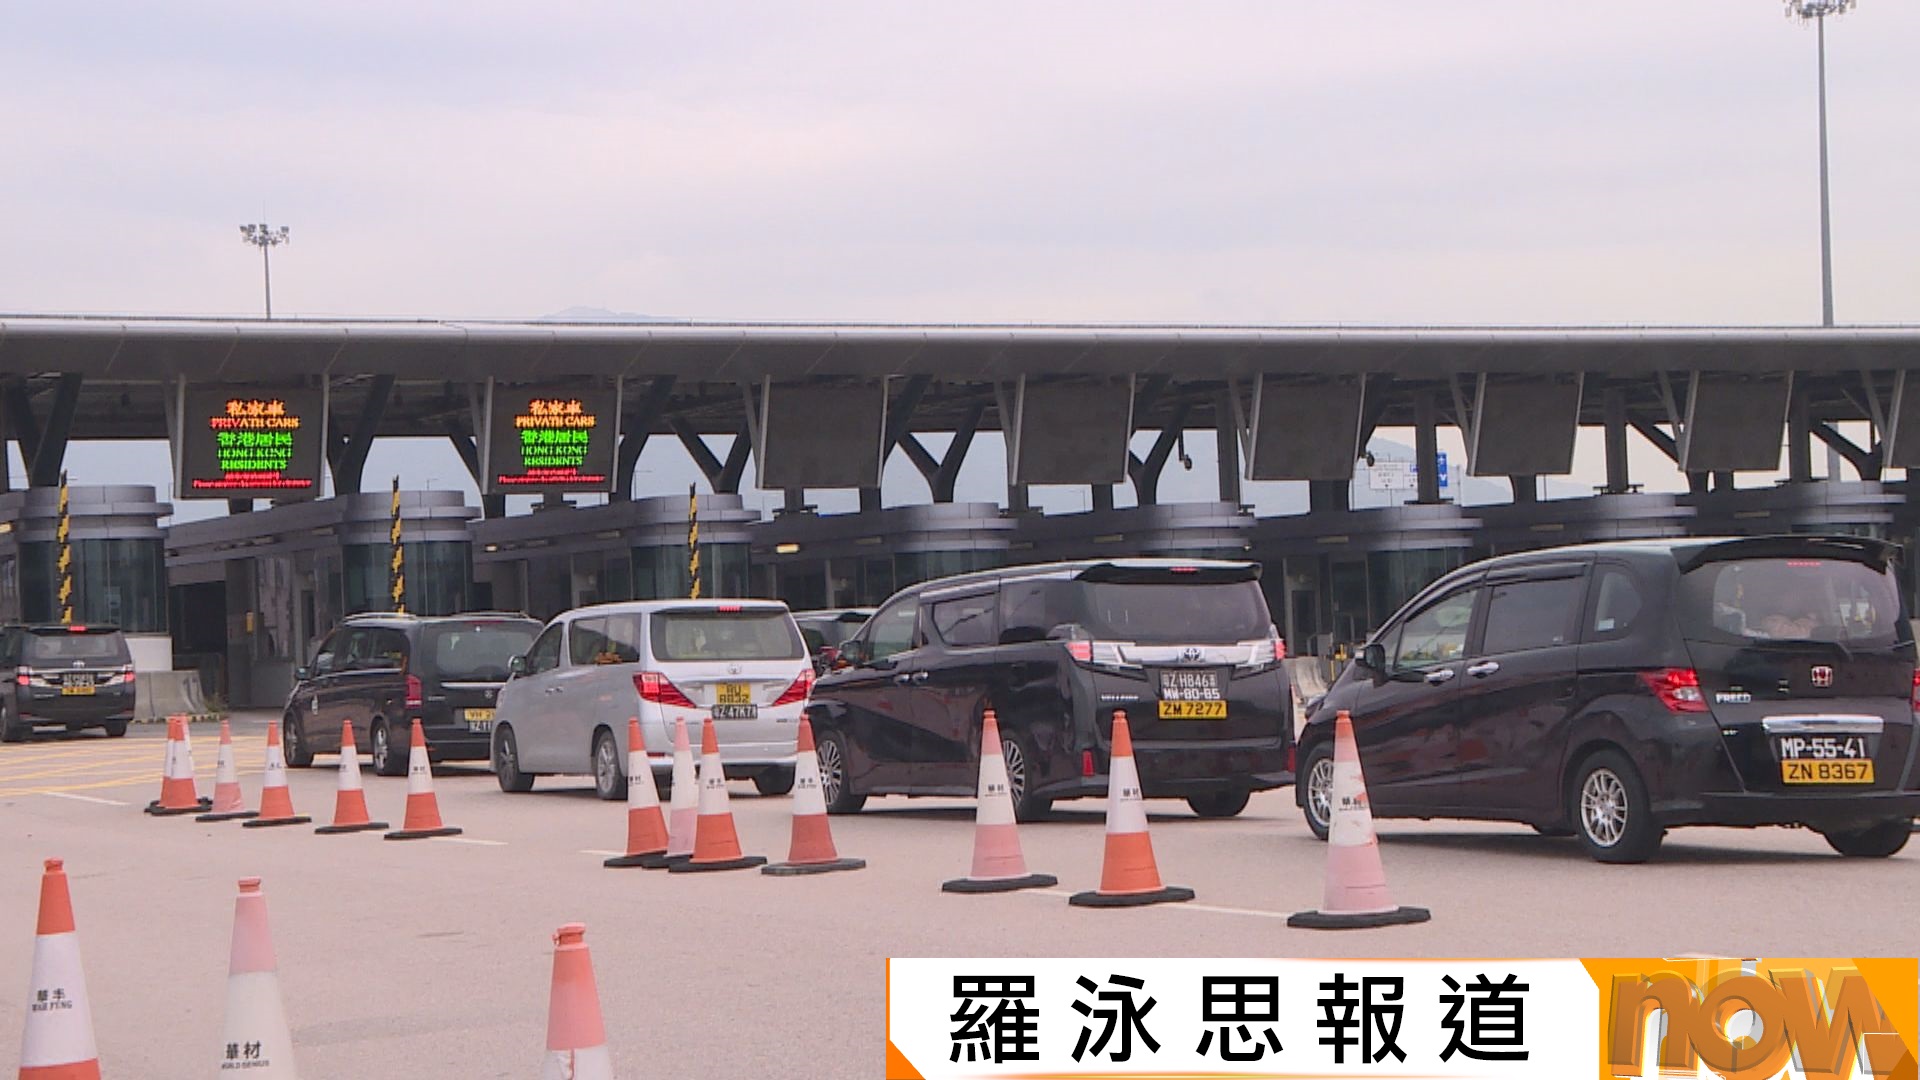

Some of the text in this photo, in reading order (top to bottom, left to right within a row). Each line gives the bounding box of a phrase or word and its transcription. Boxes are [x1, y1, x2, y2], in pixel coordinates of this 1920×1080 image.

[266, 418, 299, 428] CARS
[565, 416, 595, 427] CARS
[1163, 702, 1223, 716] ZM 7277
[1781, 738, 1866, 758] MP-55-41
[1788, 763, 1868, 780] ZN 8367
